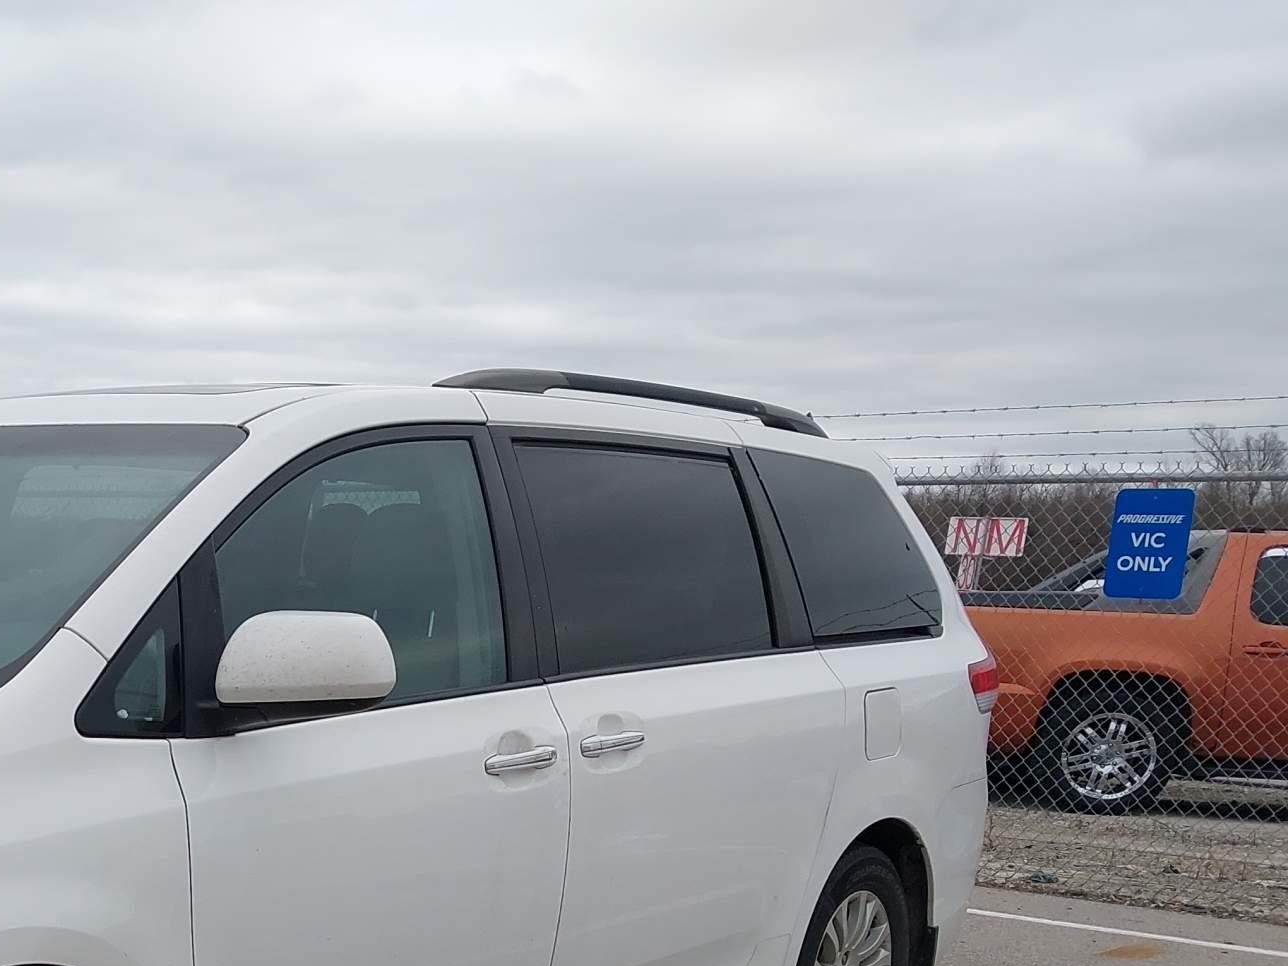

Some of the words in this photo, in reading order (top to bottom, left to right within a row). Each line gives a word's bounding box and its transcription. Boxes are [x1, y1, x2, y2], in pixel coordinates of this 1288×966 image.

[1117, 514, 1186, 524] PROGRESSIVE
[950, 518, 1026, 555] NM
[1131, 532, 1167, 548] VIC
[1117, 555, 1173, 572] ONLY
